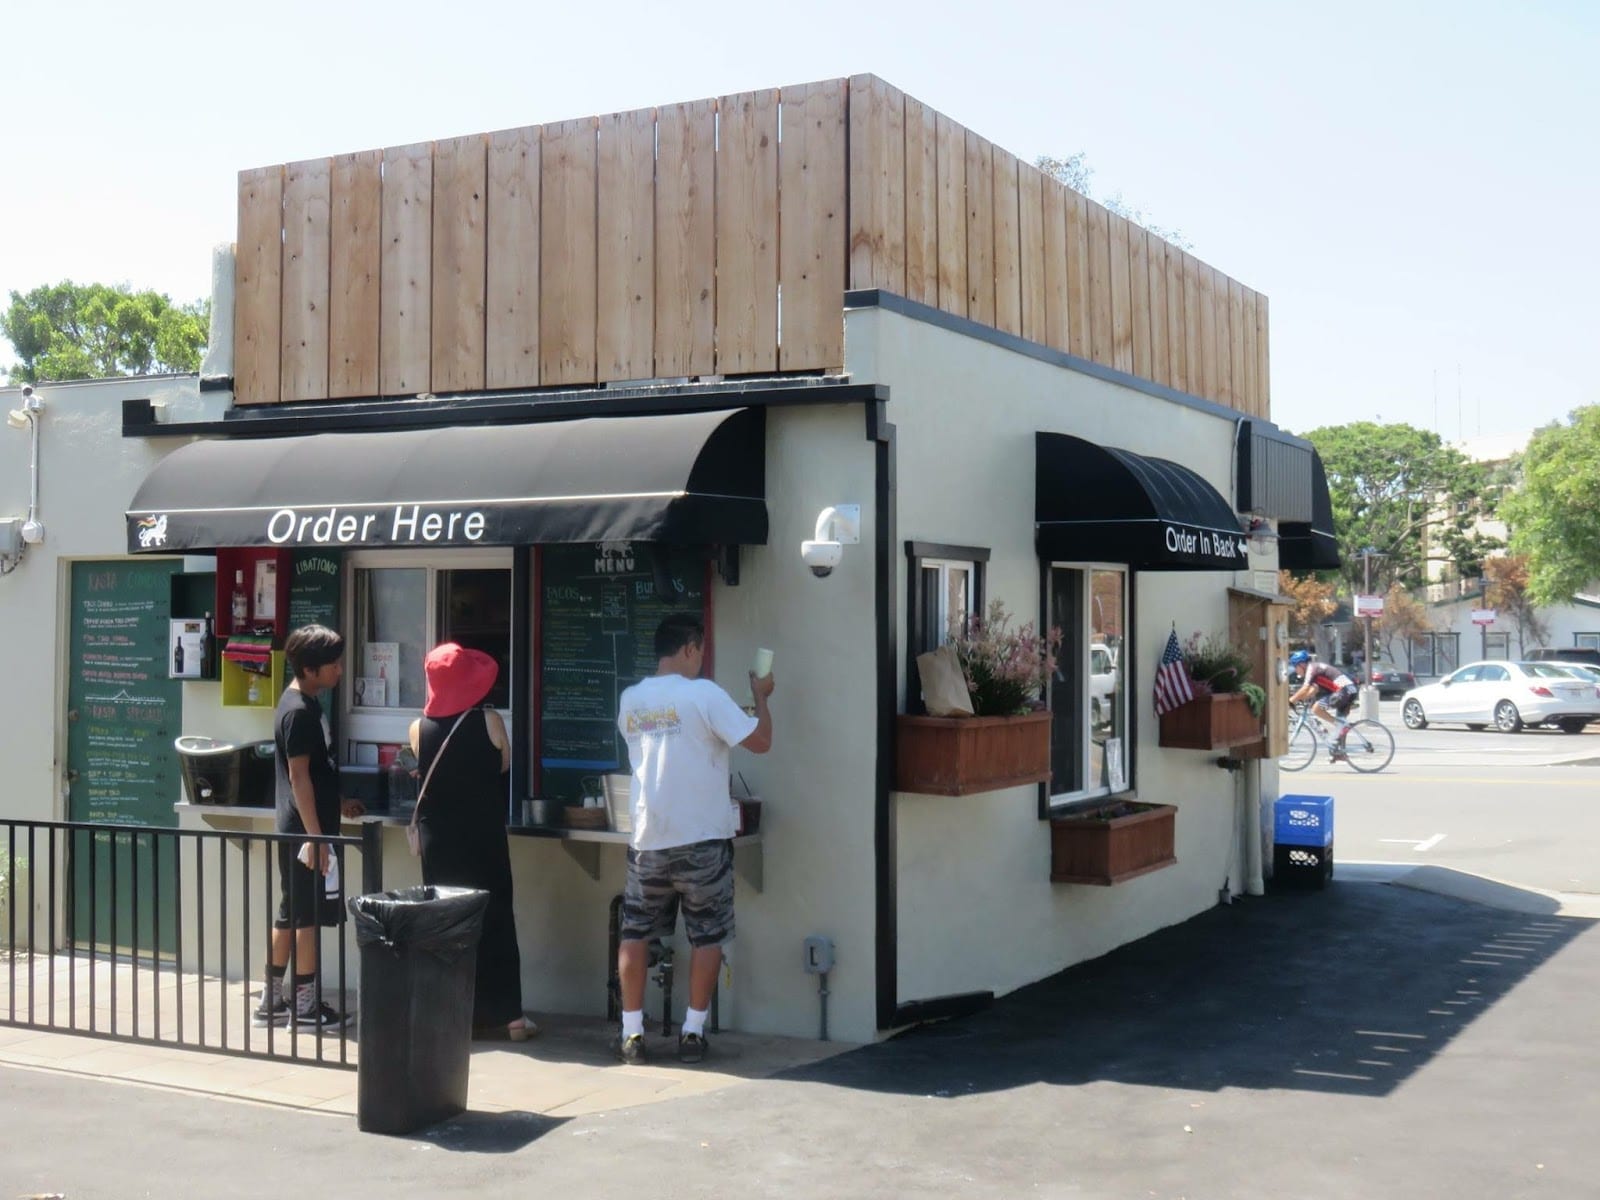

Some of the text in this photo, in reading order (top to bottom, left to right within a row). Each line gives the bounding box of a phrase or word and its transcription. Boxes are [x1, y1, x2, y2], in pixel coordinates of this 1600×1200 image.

[267, 505, 485, 543] Order Here
[1166, 527, 1236, 558] Order In Back
[296, 557, 338, 575] LIBATIONS
[594, 558, 635, 573] MENU
[546, 586, 579, 600] TACOS
